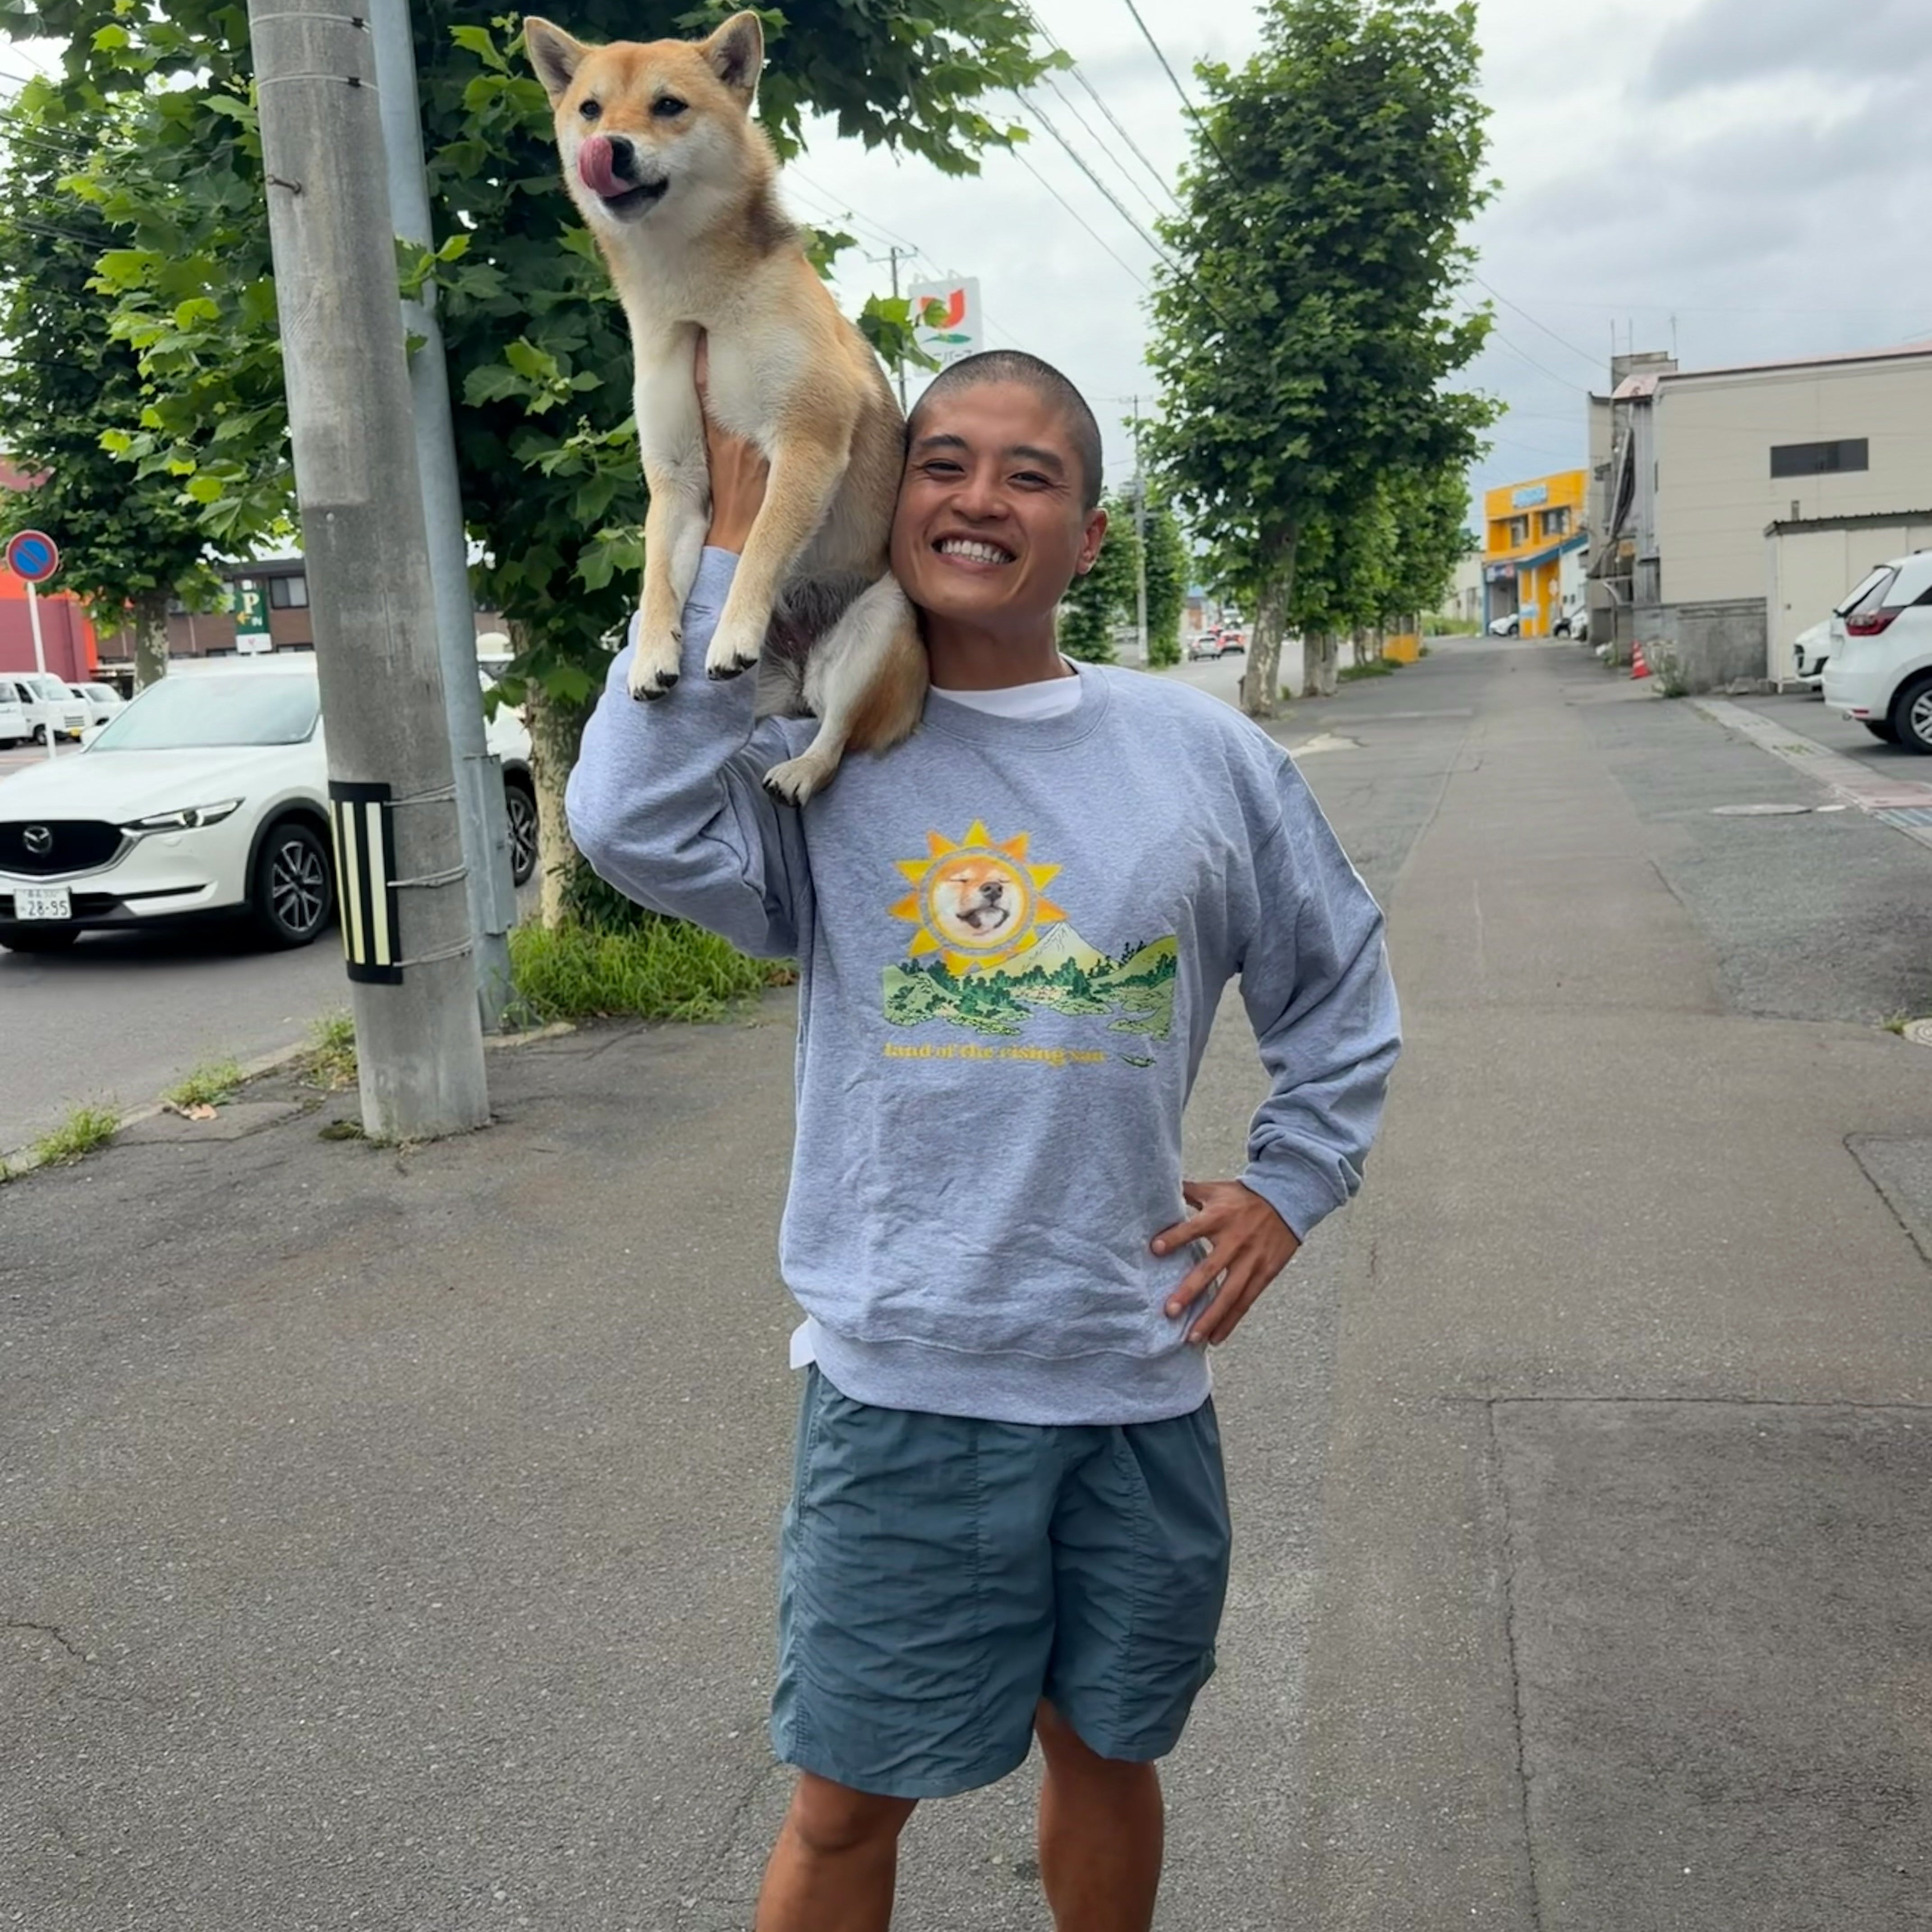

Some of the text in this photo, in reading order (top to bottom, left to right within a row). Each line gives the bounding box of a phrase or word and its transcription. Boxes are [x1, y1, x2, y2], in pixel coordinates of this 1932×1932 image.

[242, 593, 260, 614] P
[28, 901, 68, 916] 28-95
[884, 1042, 1105, 1067] land of the rising sun
